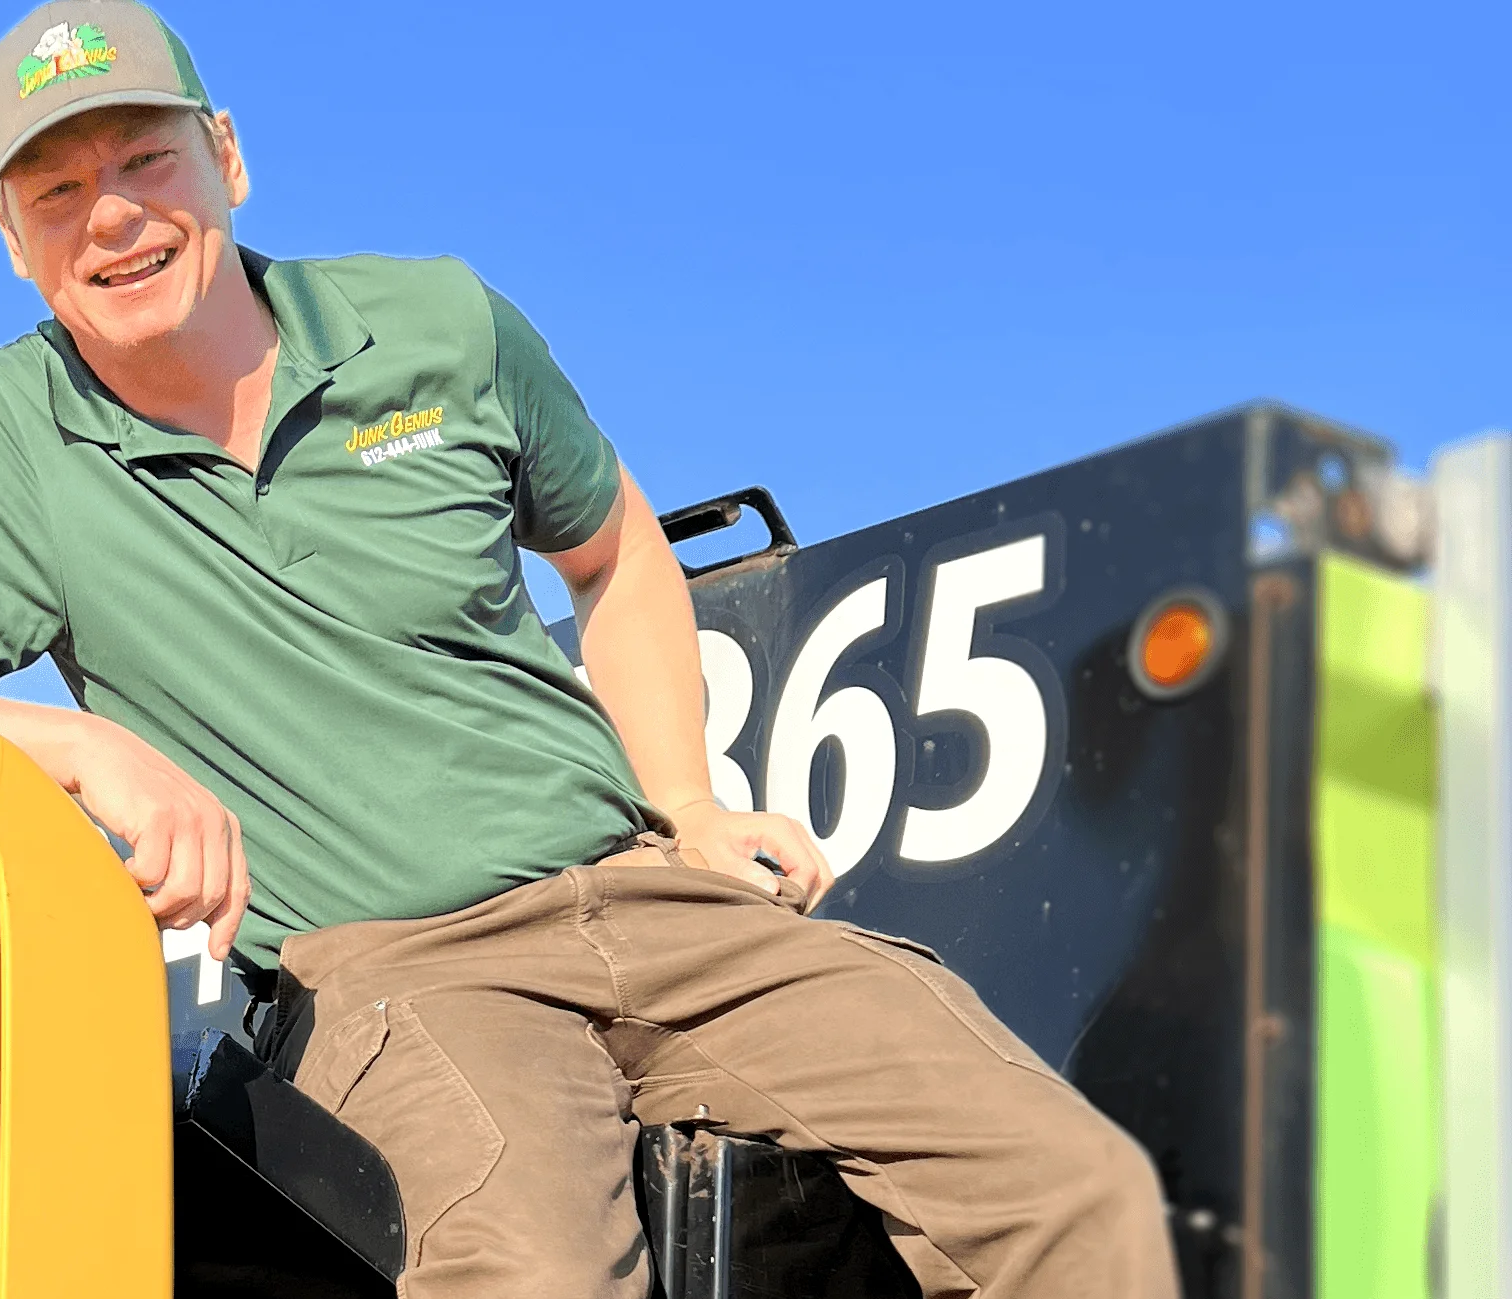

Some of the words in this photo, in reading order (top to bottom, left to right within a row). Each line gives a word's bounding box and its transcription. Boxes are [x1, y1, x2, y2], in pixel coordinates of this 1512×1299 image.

[345, 421, 390, 452] JUNK
[390, 406, 444, 437] GENIUS
[360, 427, 445, 466] 612-444-JUNK
